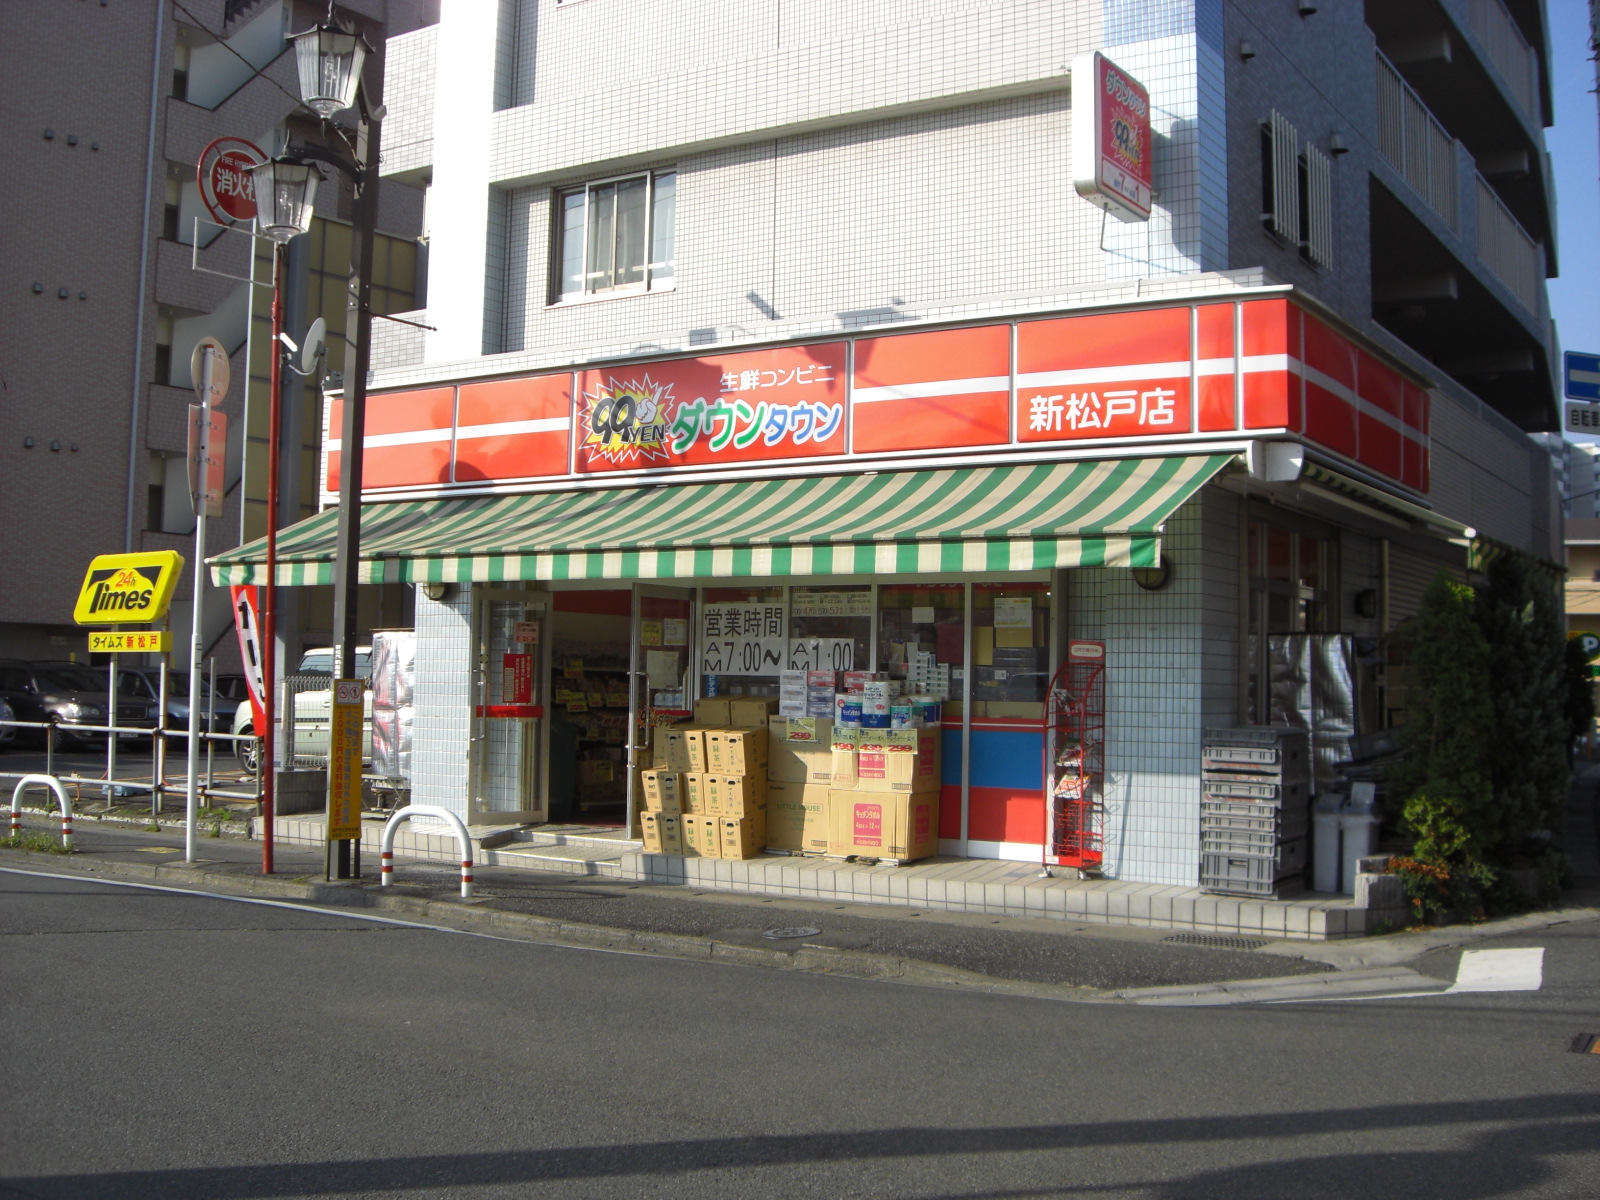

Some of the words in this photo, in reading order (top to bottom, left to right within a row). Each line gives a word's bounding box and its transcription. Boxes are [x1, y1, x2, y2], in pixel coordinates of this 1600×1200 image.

[1106, 69, 1147, 117] ダウンタウン
[1115, 120, 1130, 152] 99
[221, 156, 234, 166] FIRE
[719, 365, 835, 393] 生鮮コンビニ
[591, 395, 636, 445] 99
[1029, 387, 1176, 432] 新松戸店
[628, 424, 667, 444] YEN
[671, 397, 844, 454] ダウンタウン
[89, 582, 153, 614] Times
[704, 607, 783, 638] 営業時間
[811, 642, 852, 671] 1:00
[776, 803, 800, 812] LITTLE
